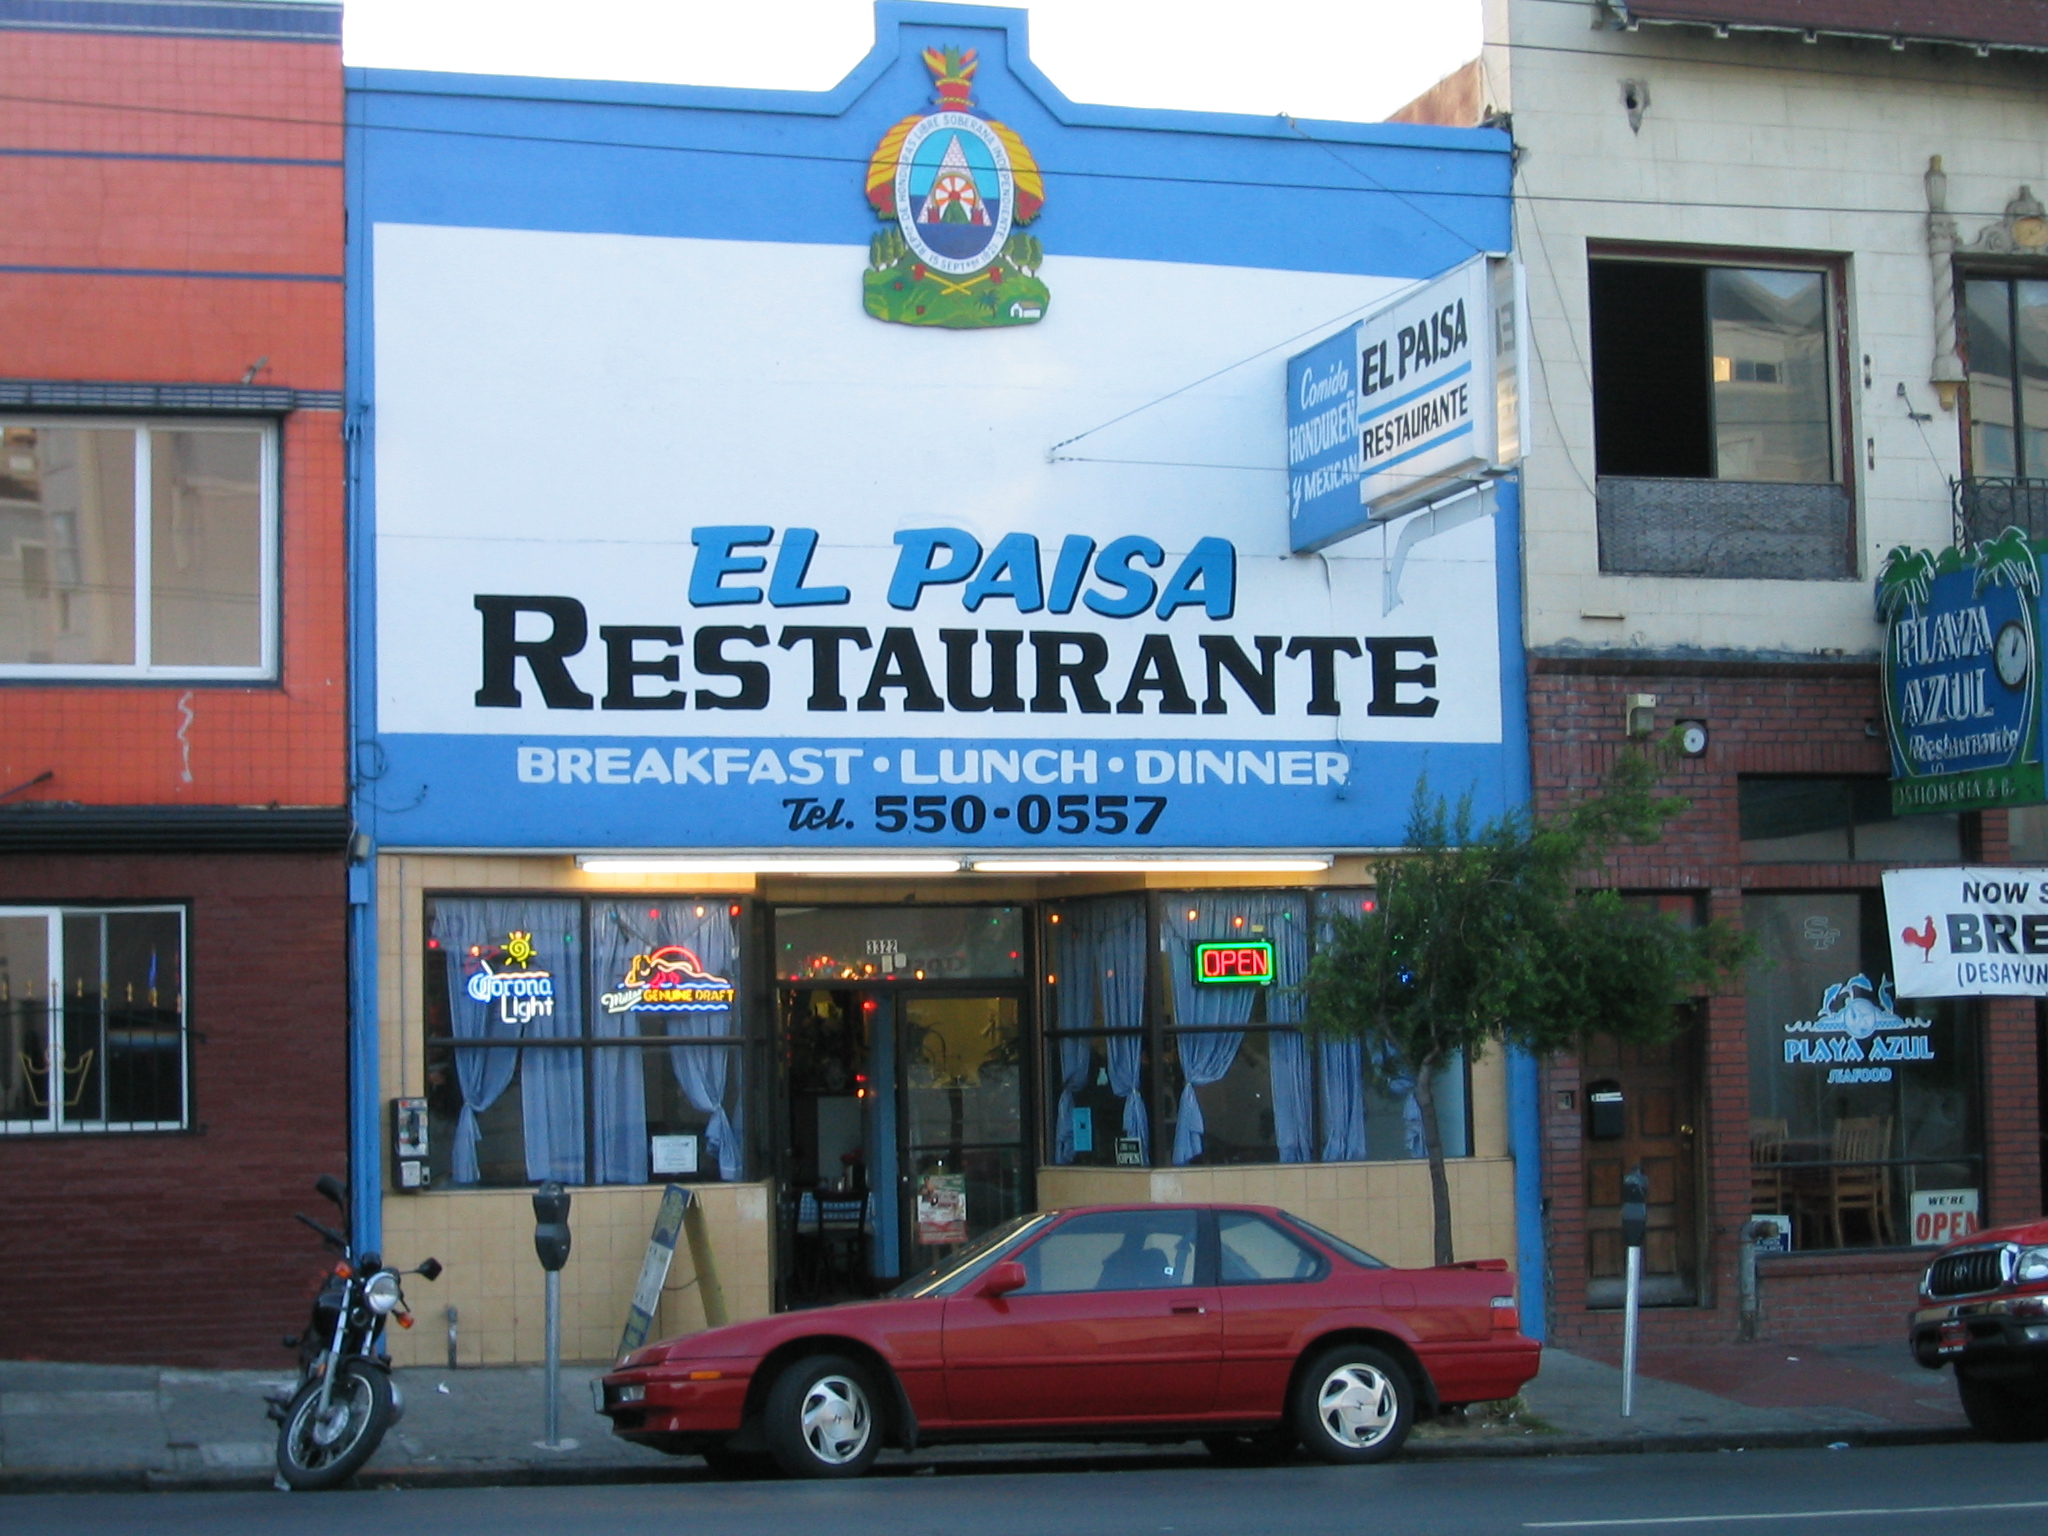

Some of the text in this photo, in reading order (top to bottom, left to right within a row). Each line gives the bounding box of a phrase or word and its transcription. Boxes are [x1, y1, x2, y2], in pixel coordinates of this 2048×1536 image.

[916, 116, 940, 139] LIBRE
[943, 114, 996, 145] SOBERANA
[1362, 340, 1394, 396] EL
[1398, 297, 1468, 381] PAISA
[1302, 360, 1349, 410] Comida
[1363, 382, 1468, 462] RESTAURANTE
[688, 525, 1237, 621] EL PAISA
[1896, 606, 1993, 668] PLAYA
[473, 594, 1440, 719] RESTAURANTE
[1901, 669, 1995, 727] AZUL
[517, 747, 1351, 786] BREAKFAST LUNCH DINNER
[783, 794, 1168, 836] Tel. 550-0557
[1962, 882, 2030, 904] NOW
[866, 940, 898, 955] 3322
[1946, 914, 2048, 955] BRE
[1204, 949, 1267, 977] OPEN
[468, 973, 553, 1003] Corona
[643, 988, 694, 1002] GENUINE
[695, 988, 735, 1003] DRAFT
[501, 994, 554, 1023] Light
[1784, 1035, 1935, 1064] PLAYA AZUL
[1827, 1066, 1893, 1084] SEAFOOD
[1117, 1152, 1141, 1165] OPEN
[1928, 1195, 1966, 1206] WE'RE
[1916, 1210, 1979, 1241] OPEN
